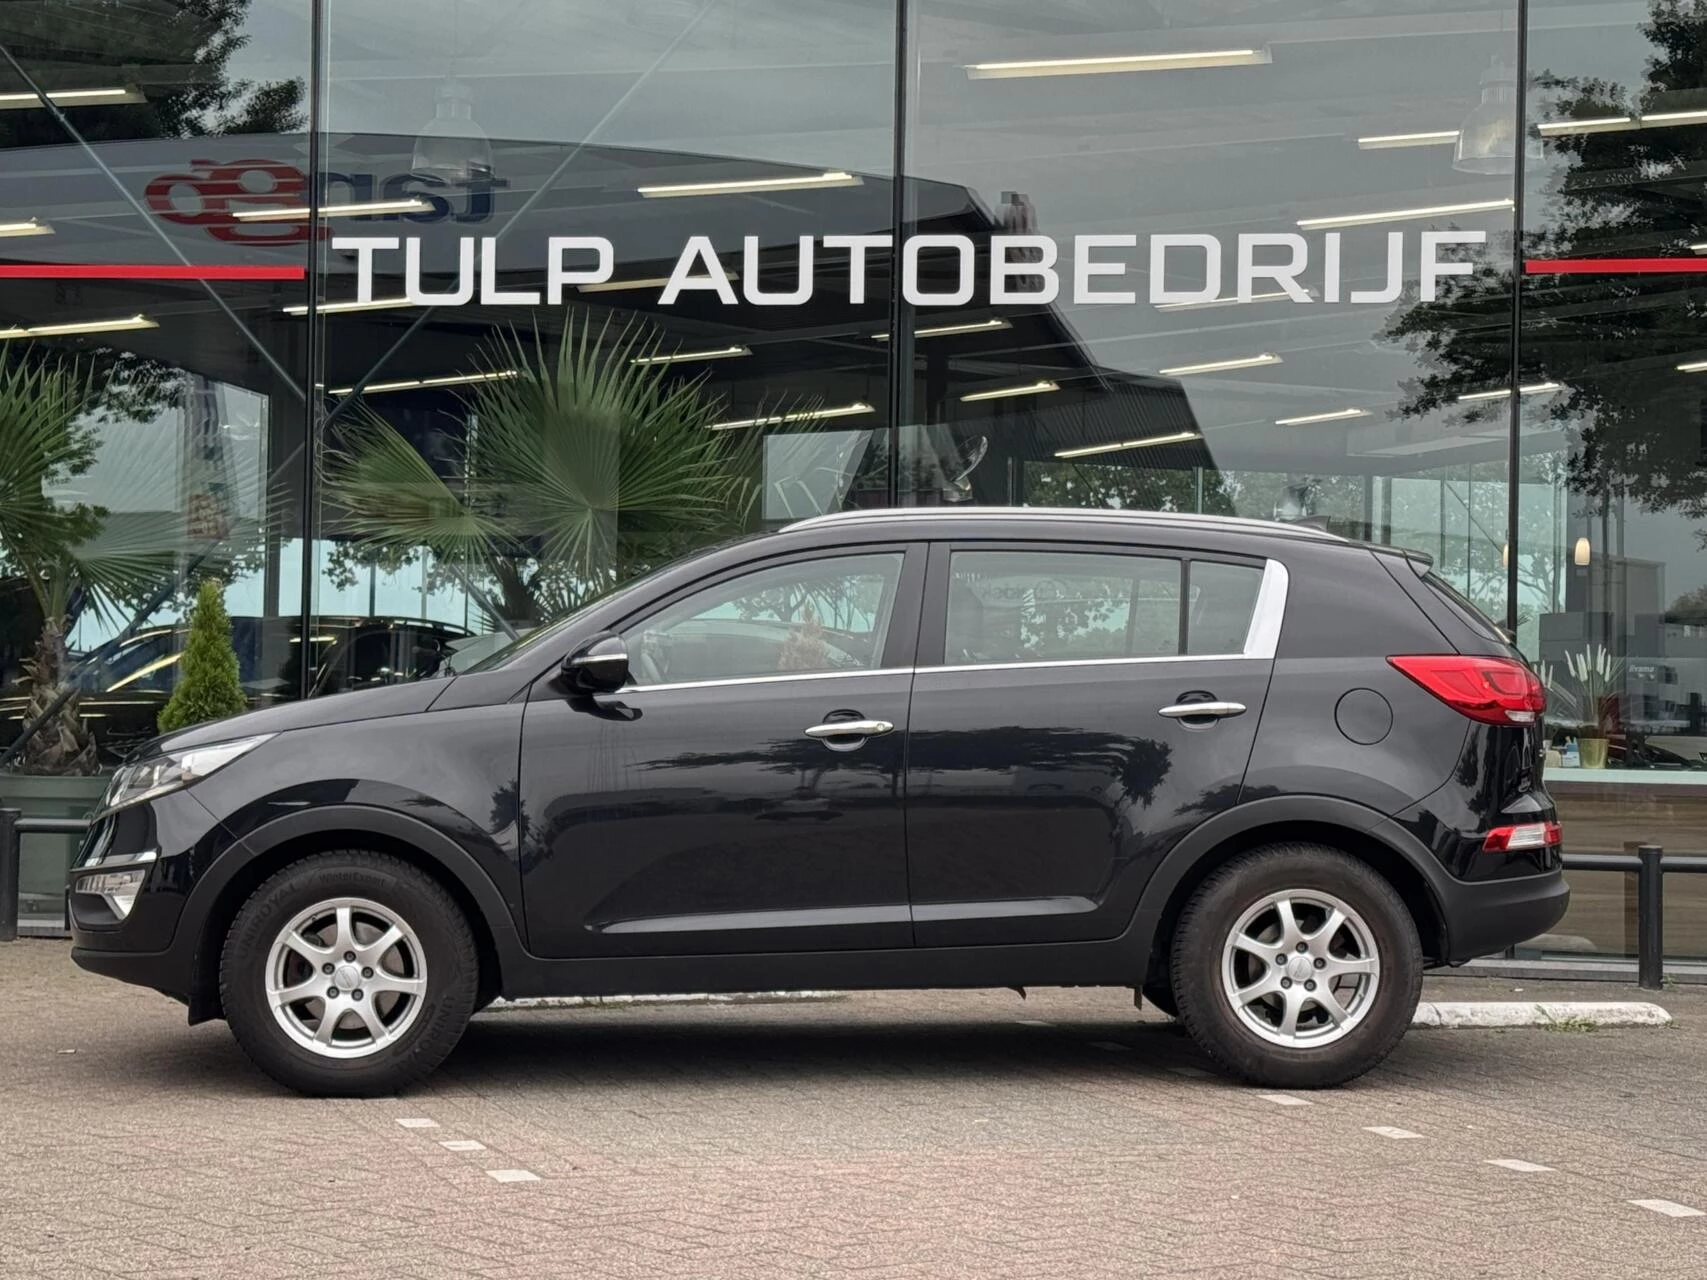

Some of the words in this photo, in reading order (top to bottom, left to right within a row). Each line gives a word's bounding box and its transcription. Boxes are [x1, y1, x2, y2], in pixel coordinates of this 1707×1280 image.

[331, 236, 615, 307] TULP
[658, 230, 1487, 306] AUTOBEDRIJF
[238, 882, 300, 960] UNIROYAL
